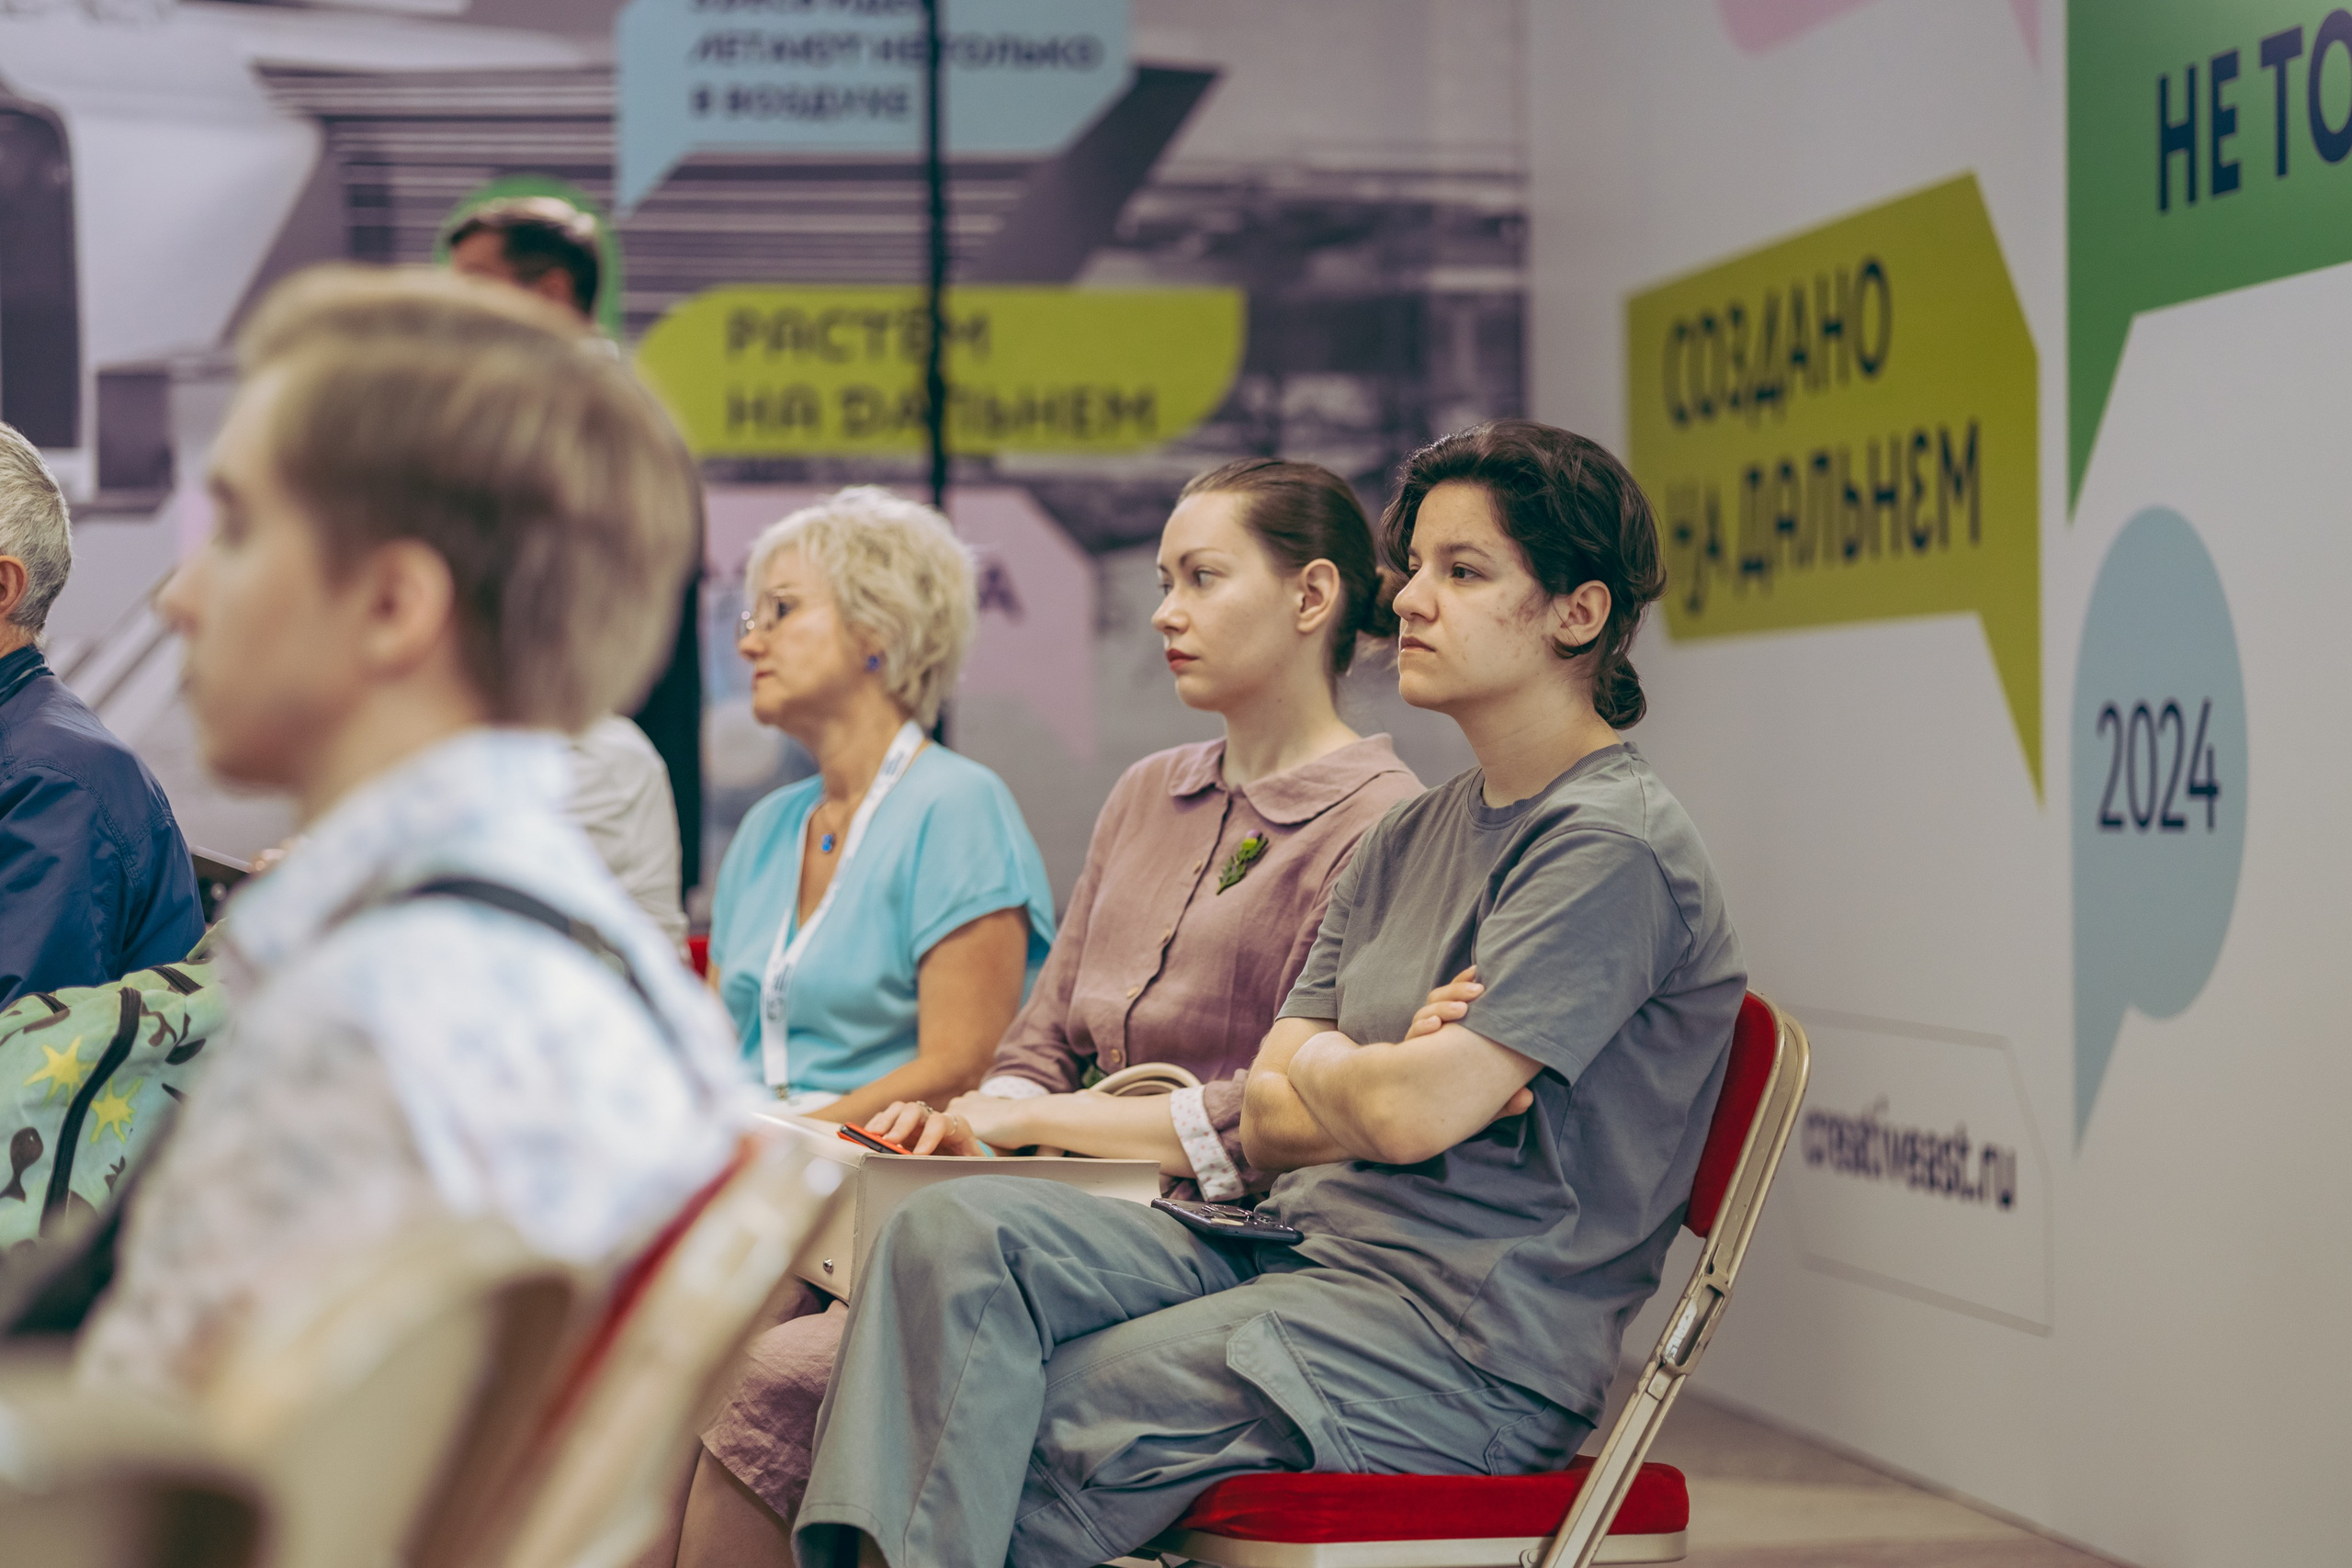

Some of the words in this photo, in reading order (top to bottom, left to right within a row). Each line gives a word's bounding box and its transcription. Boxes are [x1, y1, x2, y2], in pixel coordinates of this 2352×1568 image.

[2159, 50, 2240, 213] НЕ
[729, 384, 820, 439] НА
[1664, 256, 1892, 426] СОЗДАНО
[1735, 420, 1982, 595] ДАЛЬНЕМ
[2098, 698, 2220, 832] 2024
[1803, 1097, 2018, 1211] creativeast.ru
